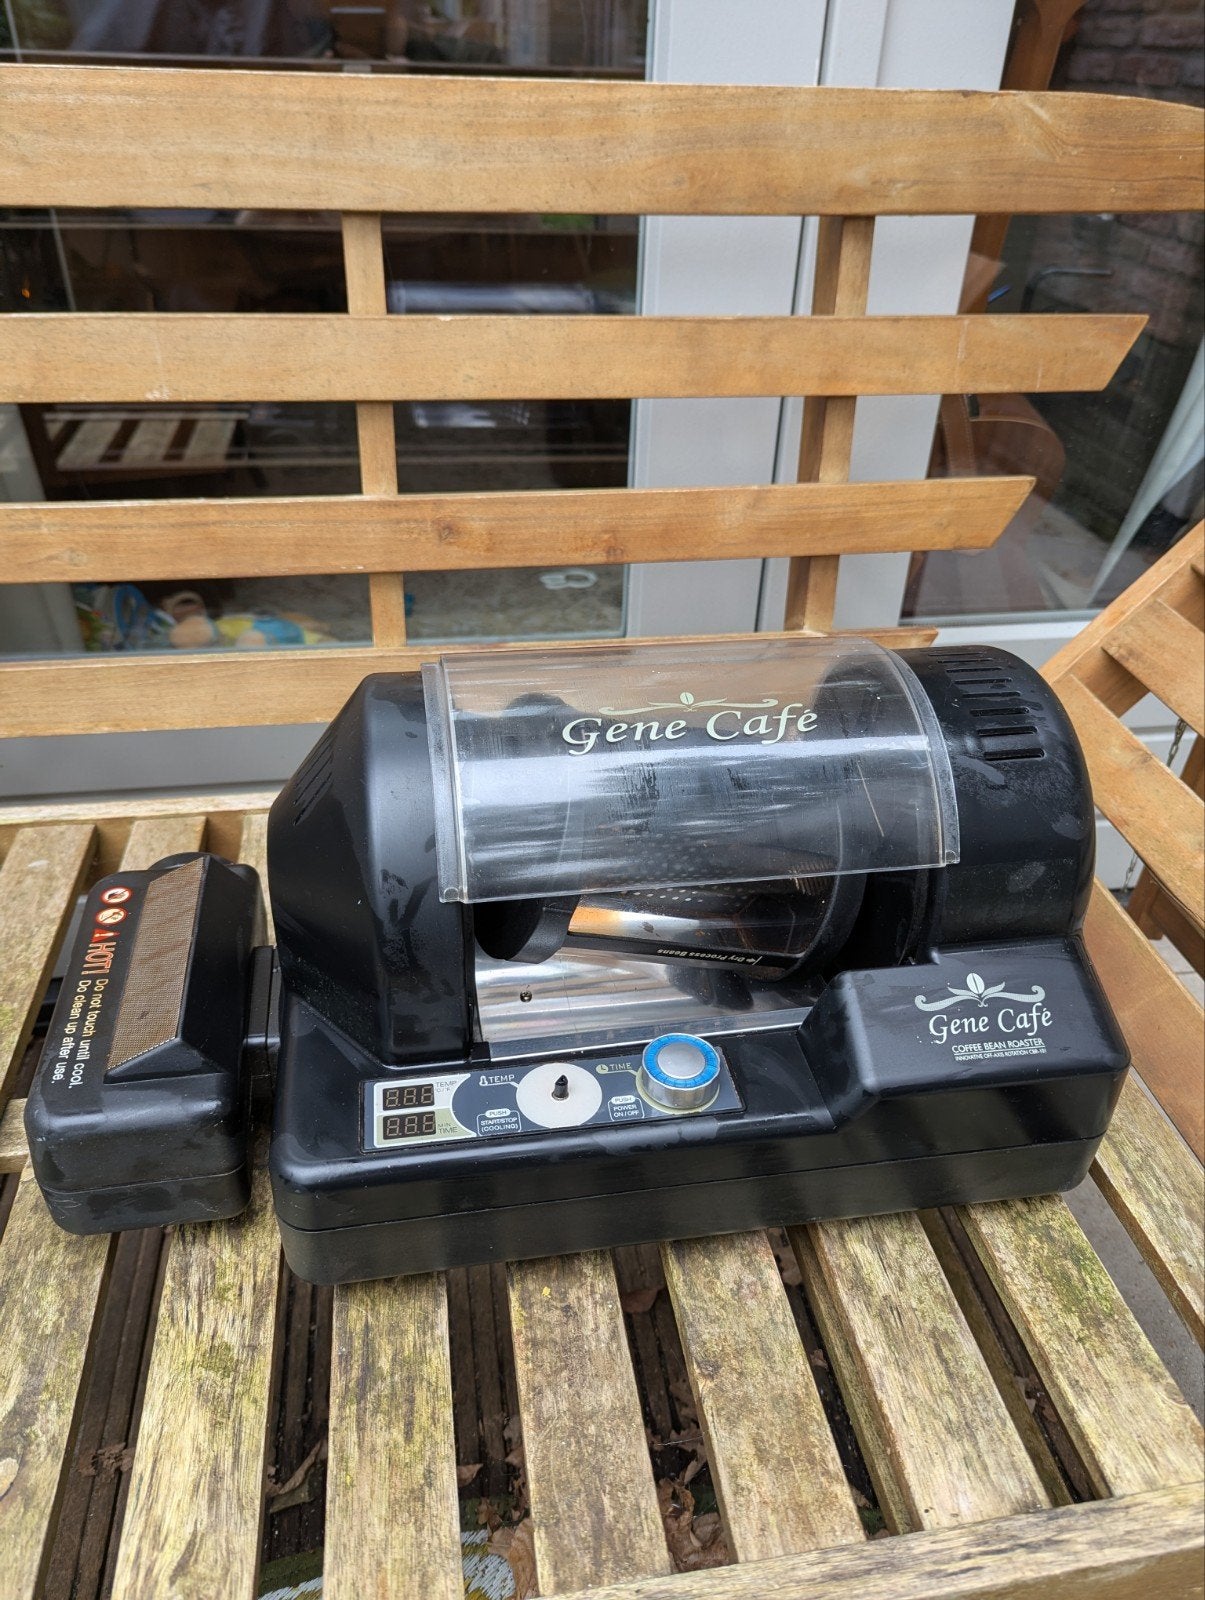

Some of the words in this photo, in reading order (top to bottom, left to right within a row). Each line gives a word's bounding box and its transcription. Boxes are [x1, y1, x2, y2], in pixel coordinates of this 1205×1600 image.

[562, 717, 687, 756] Gene
[706, 703, 818, 744] Café
[81, 942, 117, 975] HOT!
[77, 980, 91, 993] Do
[94, 979, 109, 991] Do
[69, 995, 87, 1020] clean
[89, 994, 103, 1009] not
[64, 1022, 78, 1034] up
[82, 1010, 101, 1037] touch
[928, 1014, 990, 1044] Gene
[997, 1002, 1053, 1036] Café
[58, 1037, 75, 1059] after
[76, 1040, 91, 1060] until
[951, 1043, 983, 1054] COFFEE
[983, 1041, 1006, 1051] BEAN
[1007, 1037, 1045, 1048] ROASTER
[51, 1062, 67, 1084] use.
[609, 1062, 632, 1070] TIME
[68, 1063, 85, 1089] cool.
[435, 1080, 457, 1088] TEMP
[488, 1074, 515, 1083] TEMP
[438, 1126, 458, 1135] TIME
[481, 1123, 519, 1133] (COOLING)
